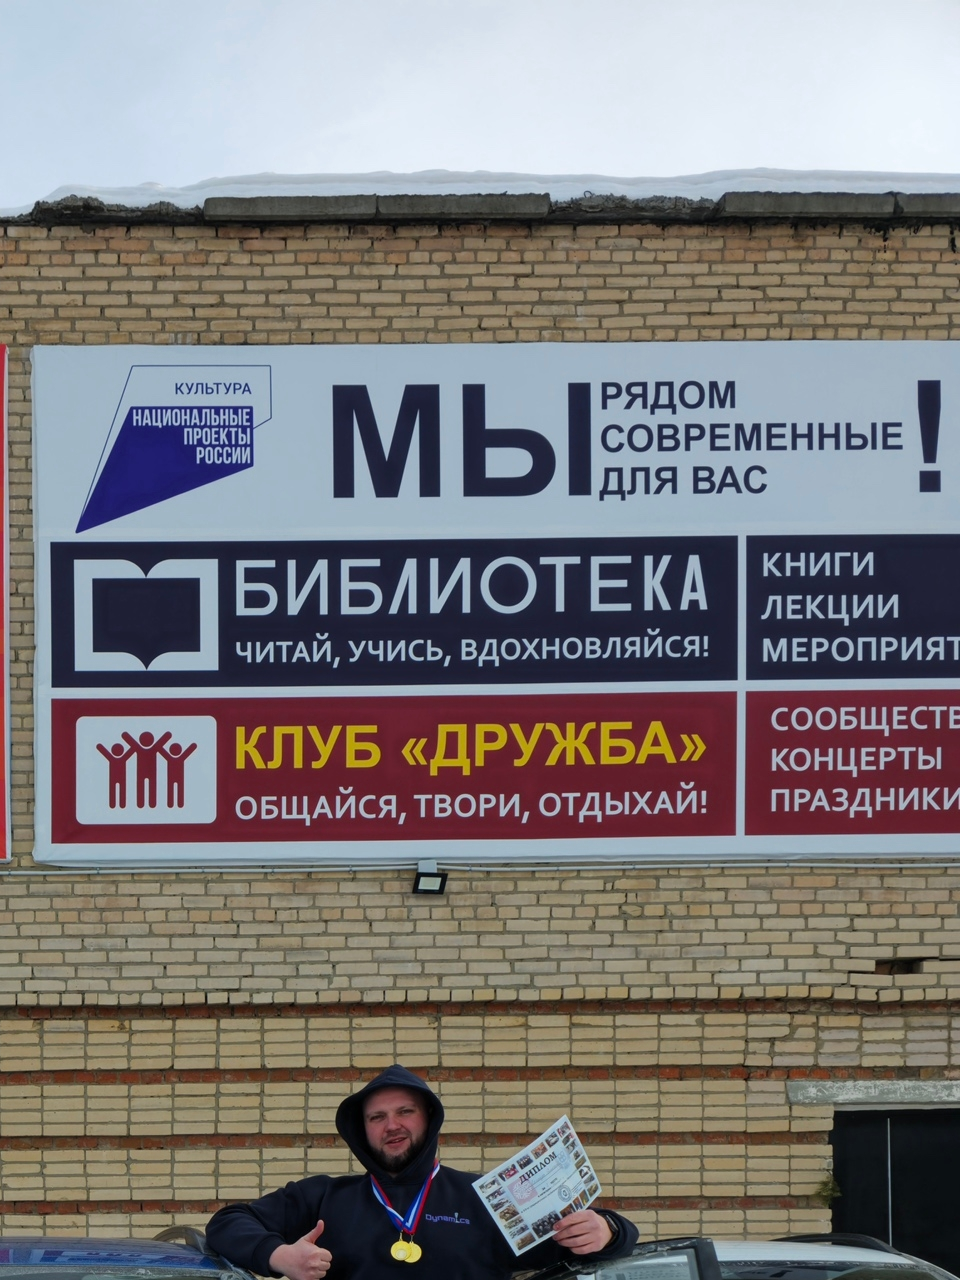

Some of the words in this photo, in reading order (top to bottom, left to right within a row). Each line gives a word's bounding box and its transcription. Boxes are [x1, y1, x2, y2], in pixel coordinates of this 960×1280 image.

[174, 382, 252, 396] КУЛЬТУРА
[600, 381, 737, 415] РЯДОМ
[132, 408, 251, 429] НАЦИОНАЛЬНЫЕ
[183, 428, 251, 446] ПРОЕКТЫ
[332, 382, 592, 499] МЫ
[600, 422, 903, 453] СОВРЕМЕННЫЕ
[196, 447, 251, 465] РОССИИ
[599, 466, 678, 501] ДЛЯ
[692, 465, 768, 496] ВАС
[763, 551, 874, 577] КНИГИ
[235, 553, 708, 617] БИБЛИОТЕКА
[761, 594, 899, 626] ЛЕКЦИИ
[235, 632, 341, 668] ЧИТАЙ,
[348, 639, 452, 668] УЧИСЬ,
[460, 628, 710, 668] ВДОХНОВЛЯЙСЯ!
[235, 724, 381, 770] КЛУБ
[401, 720, 707, 776] «ДРУЖБА»
[771, 746, 942, 778] КОНЦЕРТЫ
[235, 786, 406, 826] ОБЩАЙСЯ,
[414, 793, 530, 824] ТВОРИ,
[539, 781, 708, 822] ОТДЫХАЙ!
[771, 787, 960, 818] ПРАЗДНИКИ
[519, 1151, 557, 1184] ДИПЛОМ
